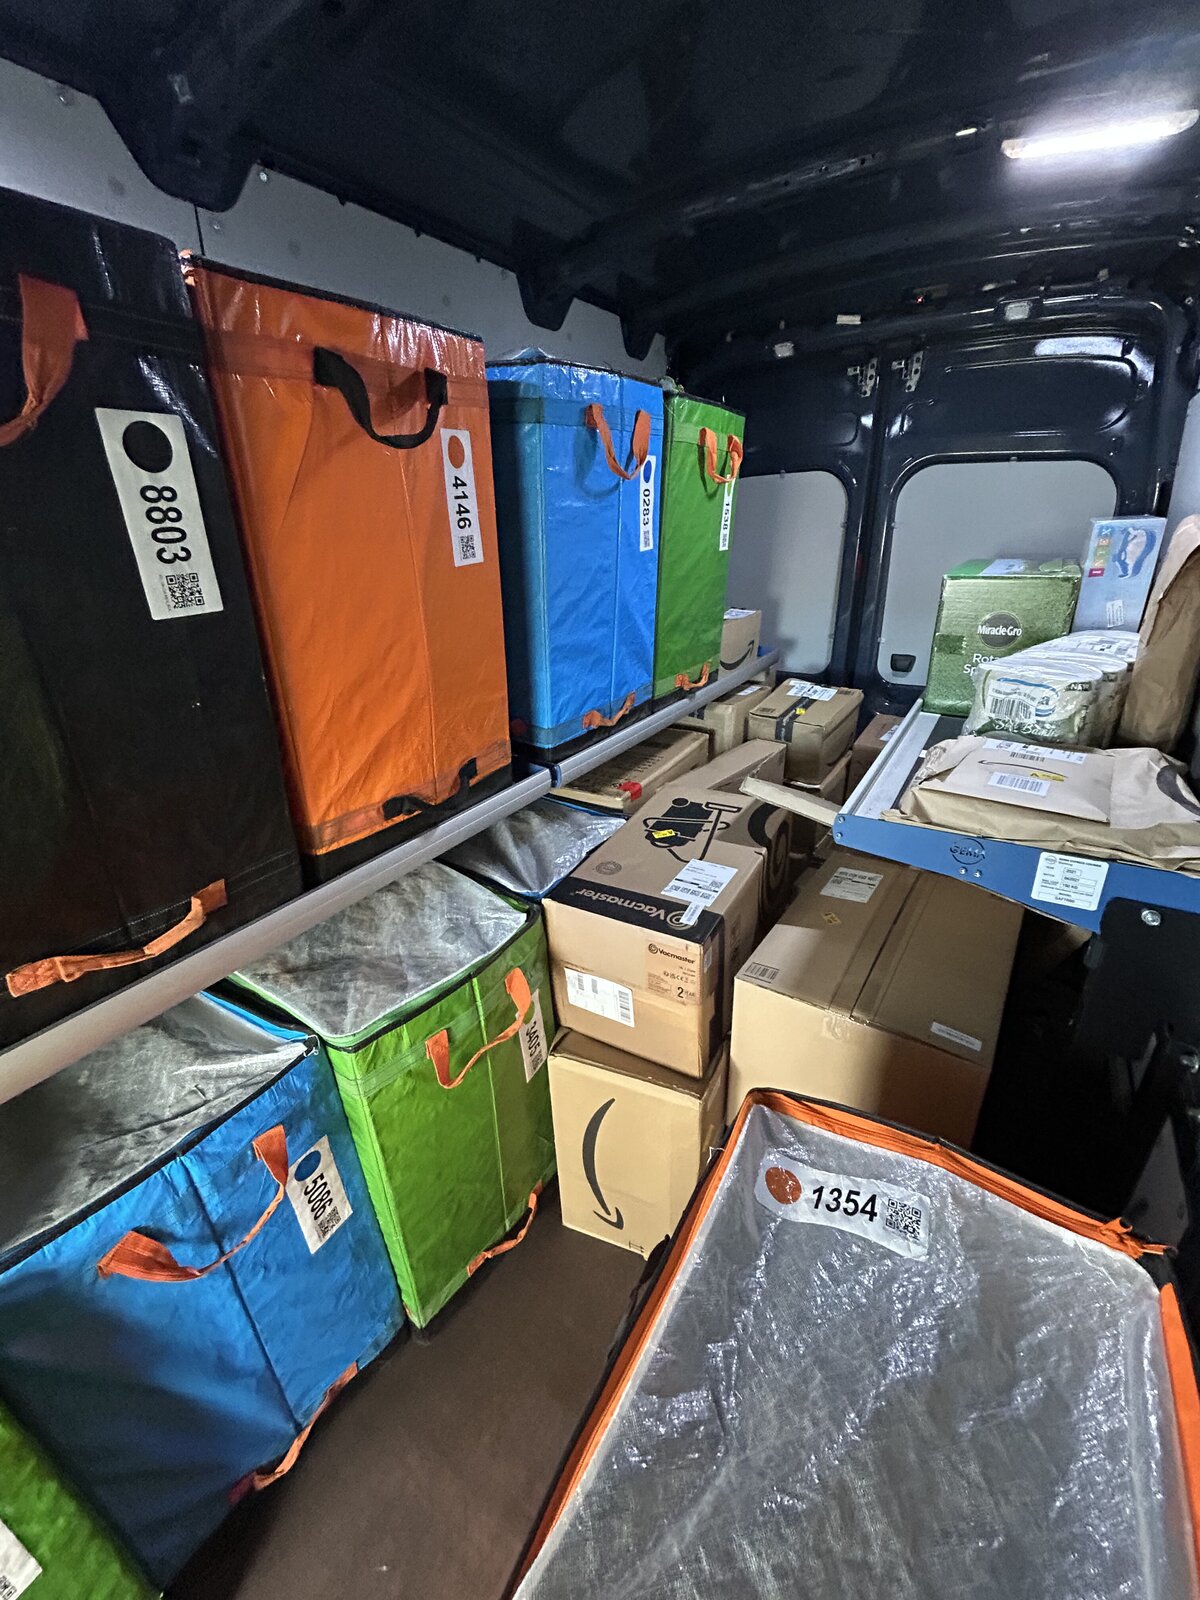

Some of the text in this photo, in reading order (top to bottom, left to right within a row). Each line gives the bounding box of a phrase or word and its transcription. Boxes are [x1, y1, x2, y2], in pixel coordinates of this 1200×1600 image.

[452, 475, 472, 530] 4146
[642, 488, 651, 527] 0283
[140, 485, 192, 564] 8803
[574, 887, 666, 920] Vacmaster
[658, 947, 695, 964] Vacmaster
[677, 986, 684, 999] 2
[525, 1020, 540, 1058] 3405
[304, 1172, 333, 1221] 5086
[811, 1185, 878, 1222] 1354
